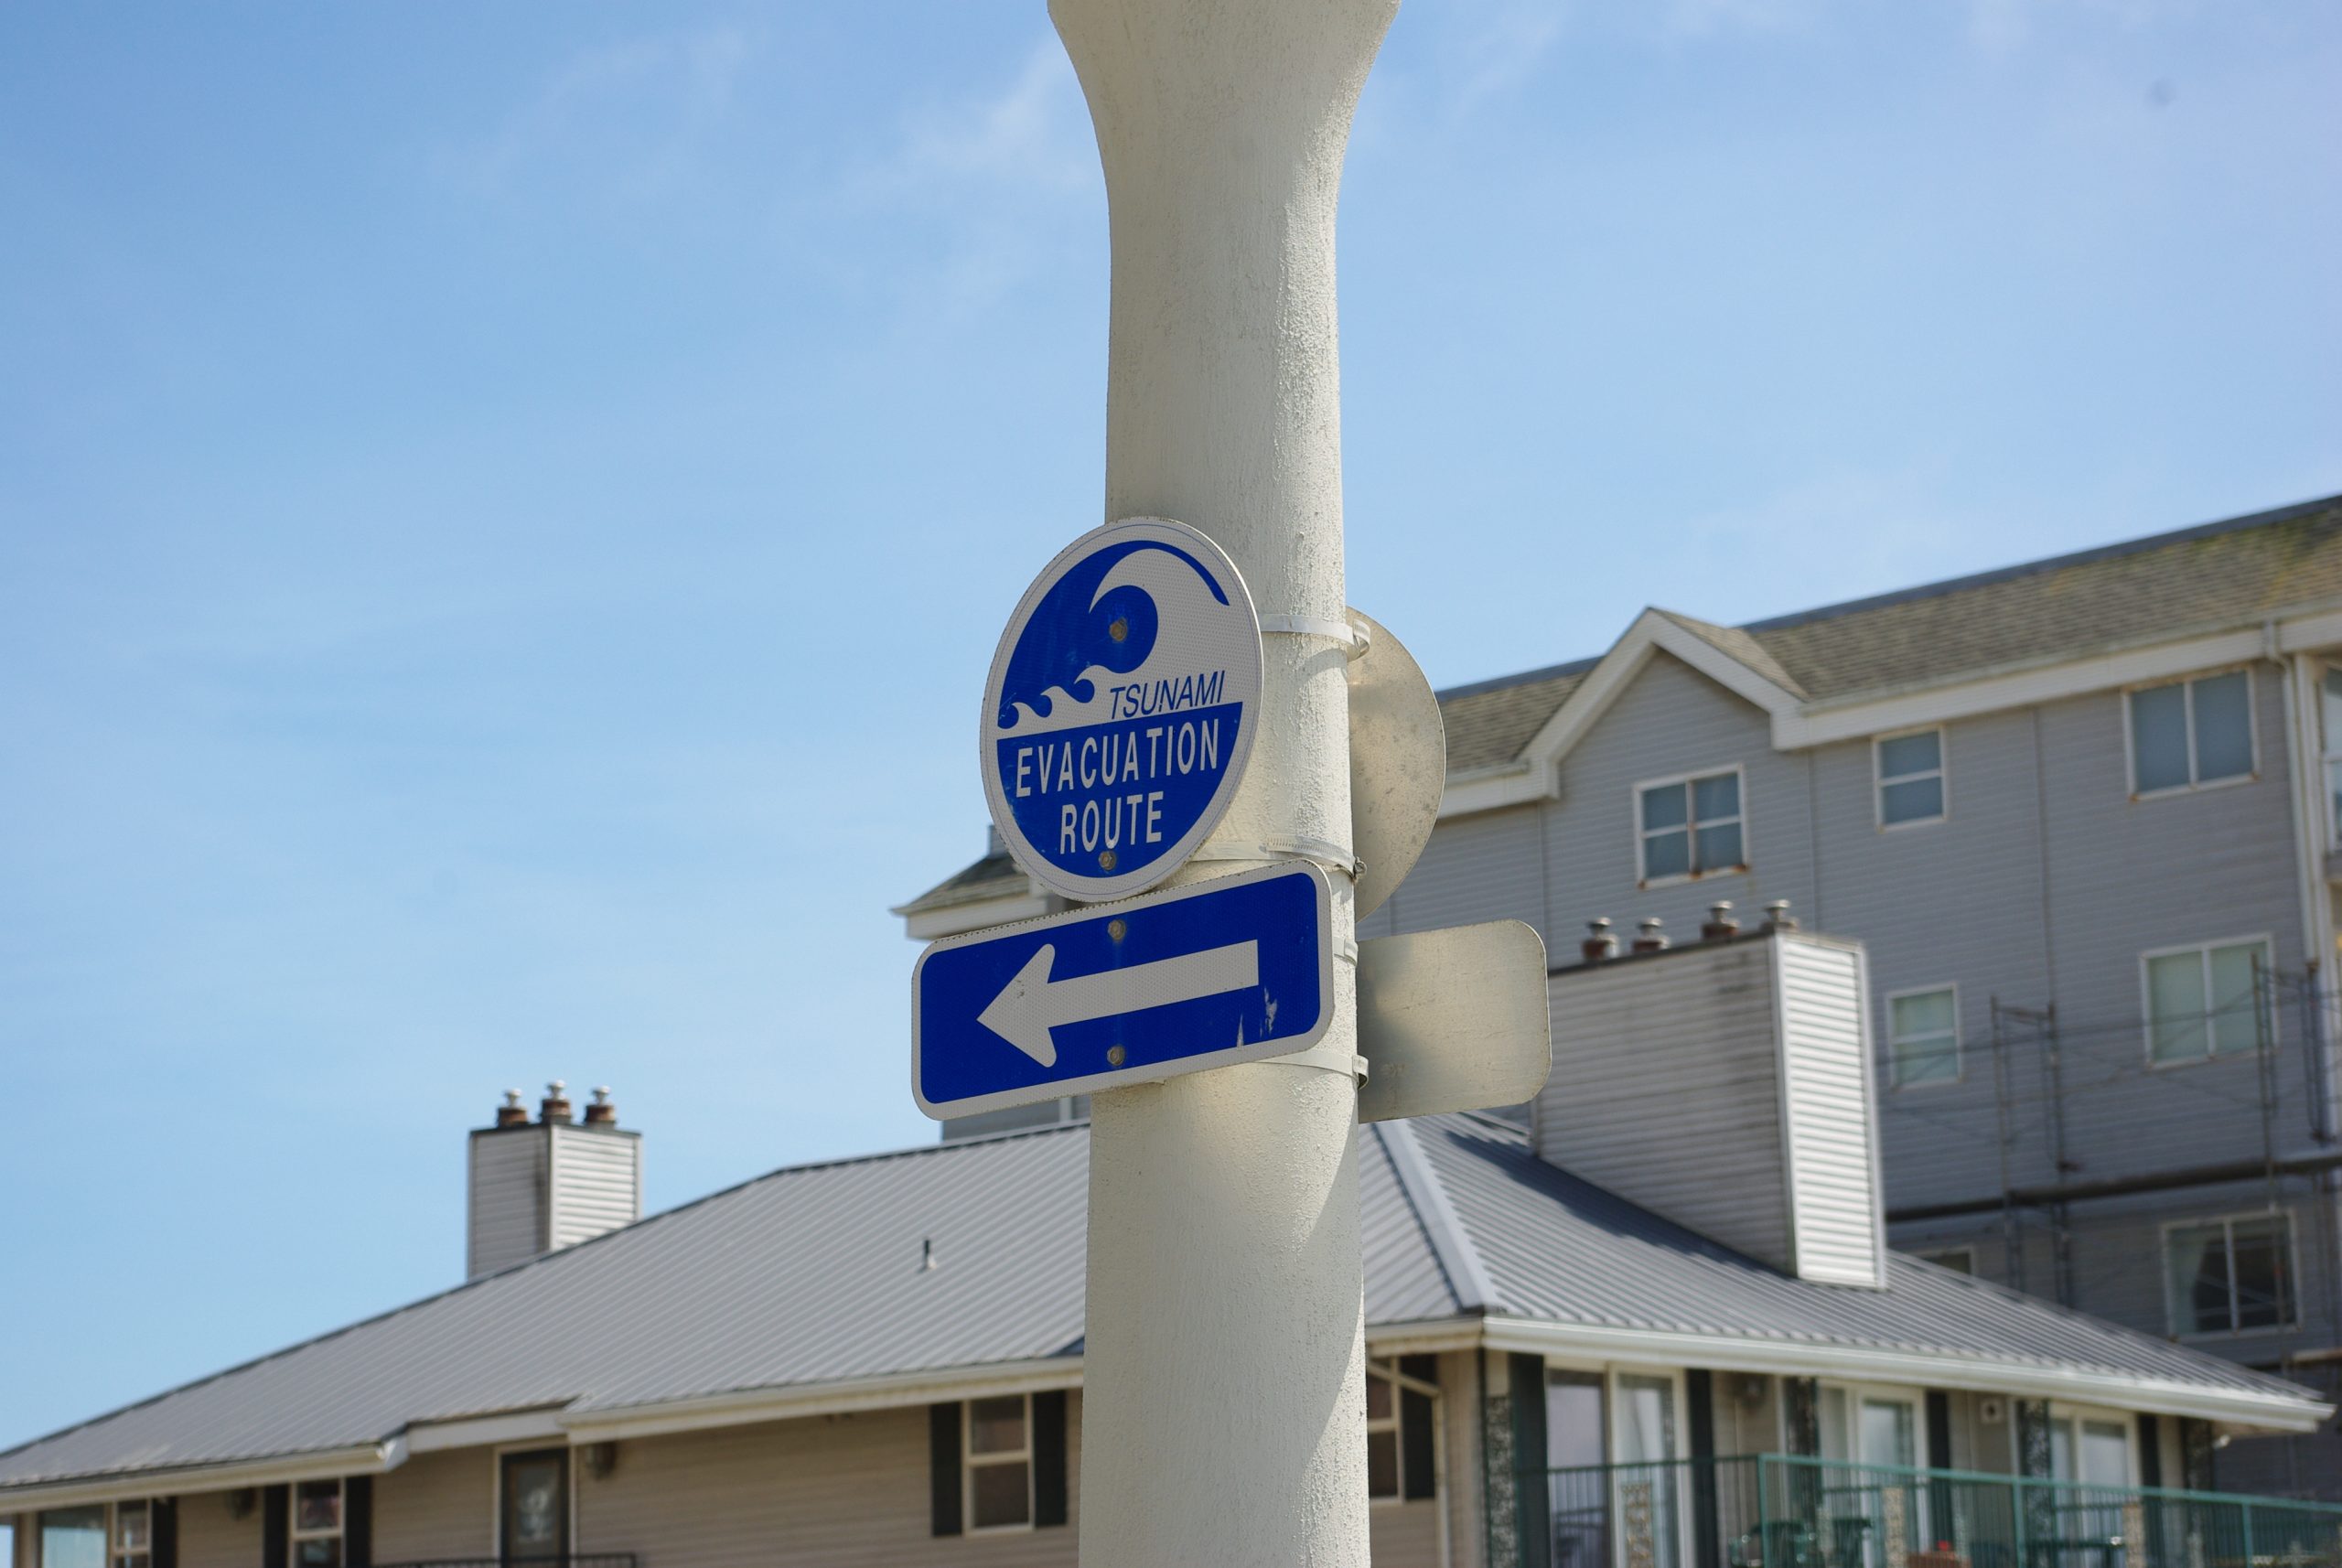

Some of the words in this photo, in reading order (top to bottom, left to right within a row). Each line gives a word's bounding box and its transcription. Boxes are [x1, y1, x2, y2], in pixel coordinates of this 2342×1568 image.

[1110, 671, 1225, 720] TSUNAMI
[1015, 719, 1219, 798] EVACUATION
[1059, 791, 1164, 854] ROUTE
